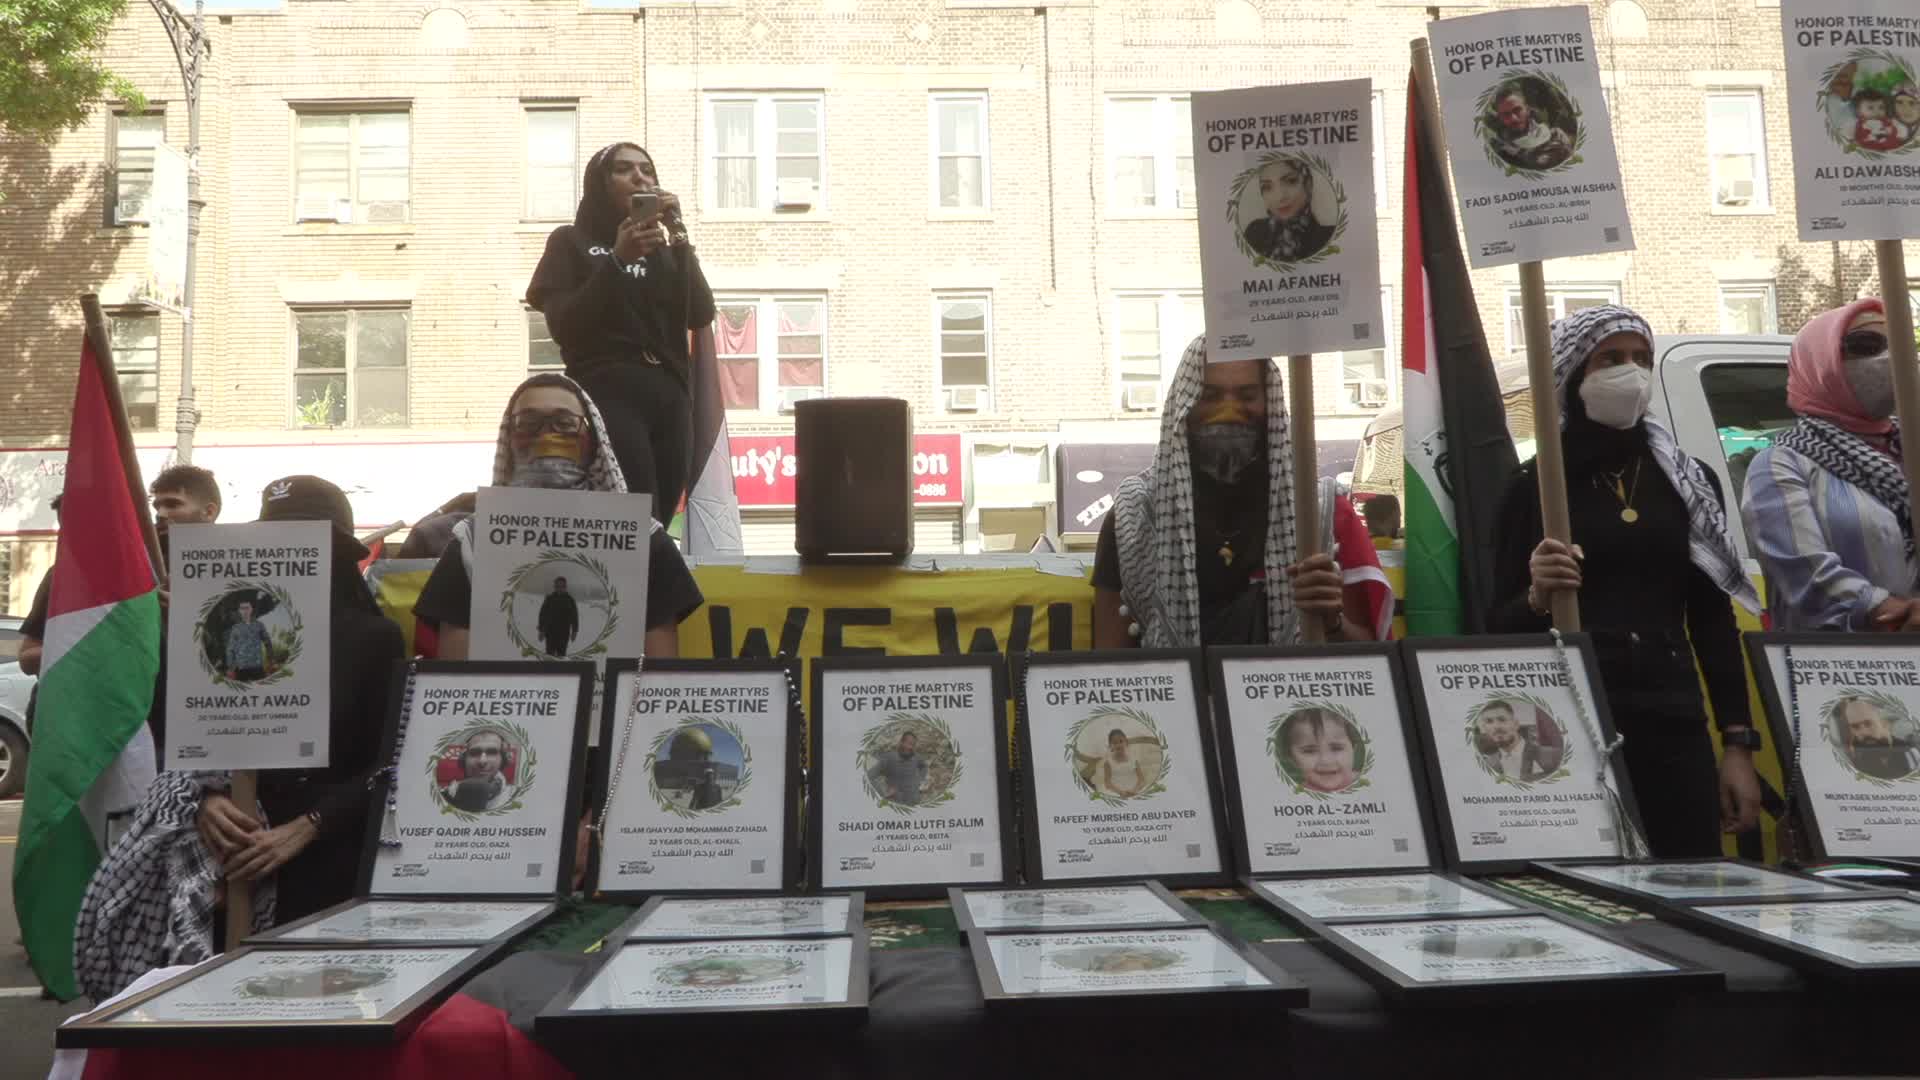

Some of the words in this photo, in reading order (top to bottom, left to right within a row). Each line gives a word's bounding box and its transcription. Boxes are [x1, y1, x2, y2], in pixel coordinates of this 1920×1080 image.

[1794, 16, 1844, 28] HONOR
[1848, 16, 1874, 27] THE
[1876, 16, 1920, 28] MARTY
[1445, 41, 1493, 56] HONOR
[1498, 37, 1523, 47] THE
[1524, 32, 1582, 45] MARTYRS
[1797, 30, 1824, 47] OF
[1448, 56, 1475, 74] OF
[1481, 46, 1584, 69] PALESTINE
[1206, 117, 1256, 131] HONOR
[1260, 114, 1287, 128] THE
[1290, 109, 1357, 125] MARTYRS
[1208, 134, 1235, 152] OF
[1241, 125, 1357, 149] PALESTINE
[1815, 167, 1838, 179] ALI
[1465, 196, 1491, 208] FADI
[1493, 192, 1529, 203] SADIQ
[1531, 187, 1570, 197] MOUSA
[1571, 183, 1616, 193] WASHHA
[1243, 279, 1272, 293] MAI
[1278, 273, 1340, 290] AFANEH
[489, 514, 539, 526] HONOR
[543, 516, 569, 528] THE
[572, 518, 637, 531] MARTYRS
[489, 528, 517, 544] OF
[523, 530, 635, 550] PALESTINE
[181, 549, 225, 560] HONOR
[228, 548, 252, 559] THE
[255, 547, 318, 558] MARTYRS
[182, 563, 207, 579] OF
[212, 561, 316, 577] PALESTINE
[1436, 663, 1479, 673] HONOR
[1481, 662, 1505, 672] THE
[1830, 659, 1855, 669] THE
[1857, 660, 1915, 669] MARTYRS
[1044, 678, 1087, 689] HONOR
[1089, 677, 1113, 687] THE
[1115, 675, 1173, 686] MARTYRS
[1242, 673, 1285, 683] HONOR
[1288, 672, 1312, 681] THE
[1314, 670, 1372, 680] MARTYRS
[1440, 675, 1463, 689] OF
[1468, 672, 1572, 688] PALESTINE
[424, 688, 469, 698] HONOR
[472, 689, 496, 698] THE
[499, 689, 559, 699] MARTYRS
[636, 687, 680, 697] HONOR
[684, 687, 707, 696] THE
[710, 687, 769, 696] MARTYRS
[842, 684, 885, 695] HONOR
[888, 683, 911, 693] THE
[915, 682, 973, 692] MARTYRS
[1245, 685, 1268, 699] OF
[1274, 682, 1374, 698] PALESTINE
[186, 695, 258, 708] SHAWKAT
[263, 694, 310, 706] AWAD
[843, 697, 867, 711] OF
[872, 694, 972, 710] PALESTINE
[1046, 691, 1069, 705] OF
[1075, 687, 1174, 704] PALESTINE
[422, 701, 448, 715] OF
[453, 701, 556, 715] PALESTINE
[636, 700, 661, 714] OF
[665, 699, 767, 713] PALESTINE
[1462, 795, 1521, 804] MOHAMMAD
[1523, 794, 1550, 802] FARID
[1553, 794, 1568, 802] ALI
[1569, 792, 1606, 802] HASAN
[1053, 815, 1088, 823] RAFEEF
[1091, 813, 1138, 822] MURSHED
[1141, 811, 1161, 820] ABU
[1163, 809, 1196, 819] DAYER
[1274, 804, 1313, 816] HOOR
[1318, 802, 1385, 814] AL-ZAMLI
[838, 821, 873, 831] SHADI
[876, 820, 910, 830] OMAR
[913, 819, 945, 829] LUTFI
[948, 817, 983, 827] SALIM
[399, 827, 433, 836] YUSEF
[436, 827, 470, 836] QADIR
[472, 827, 496, 836] ABU
[498, 827, 546, 836] HUSSEIN
